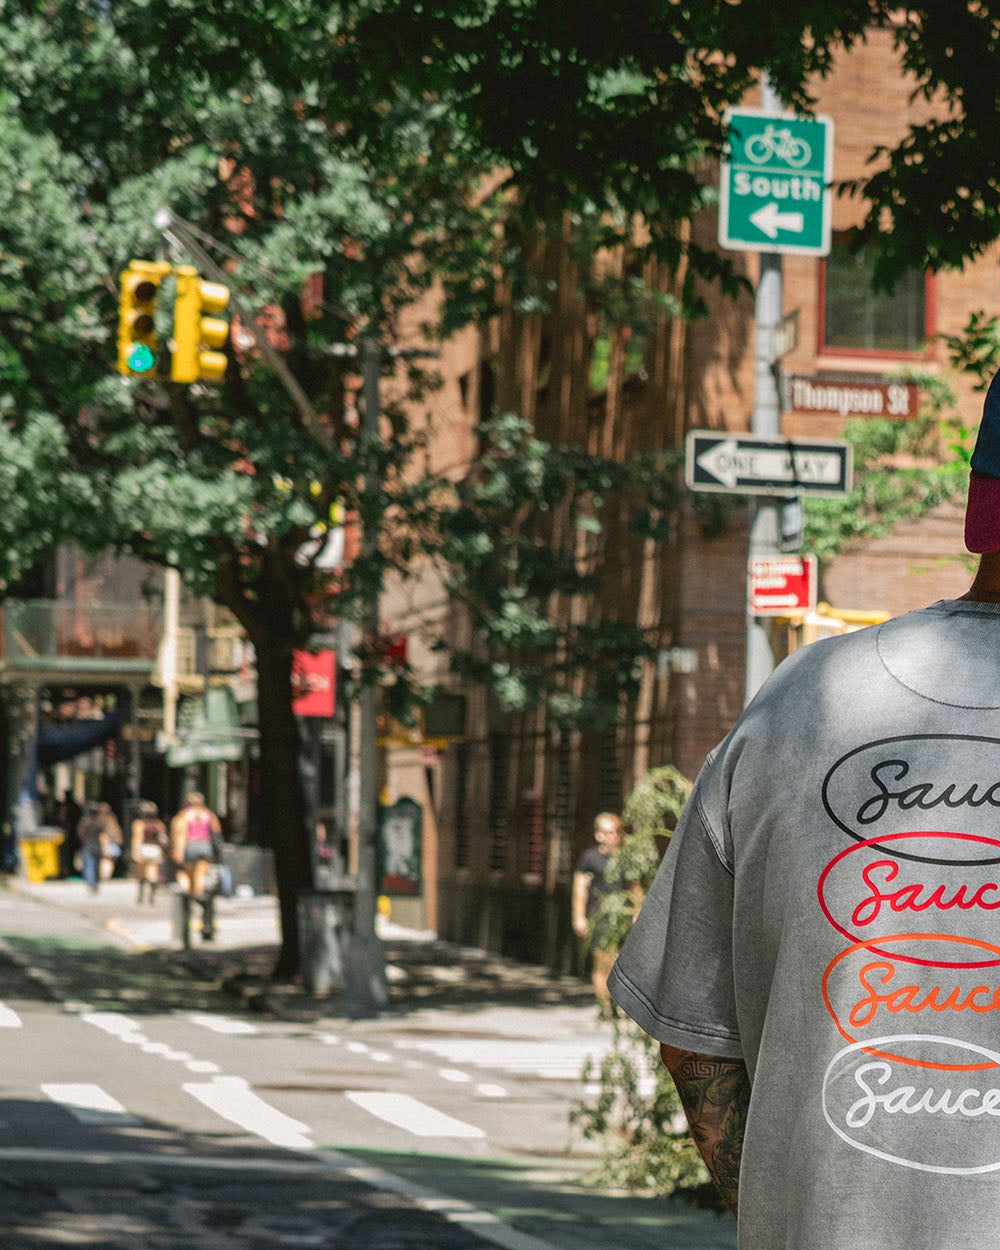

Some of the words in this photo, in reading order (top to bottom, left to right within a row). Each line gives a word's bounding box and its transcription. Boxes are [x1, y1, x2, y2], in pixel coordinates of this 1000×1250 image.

[734, 171, 821, 201] South
[794, 380, 883, 416] Thompson
[886, 385, 910, 415] St
[713, 451, 758, 478] ONE
[784, 454, 831, 480] WAY
